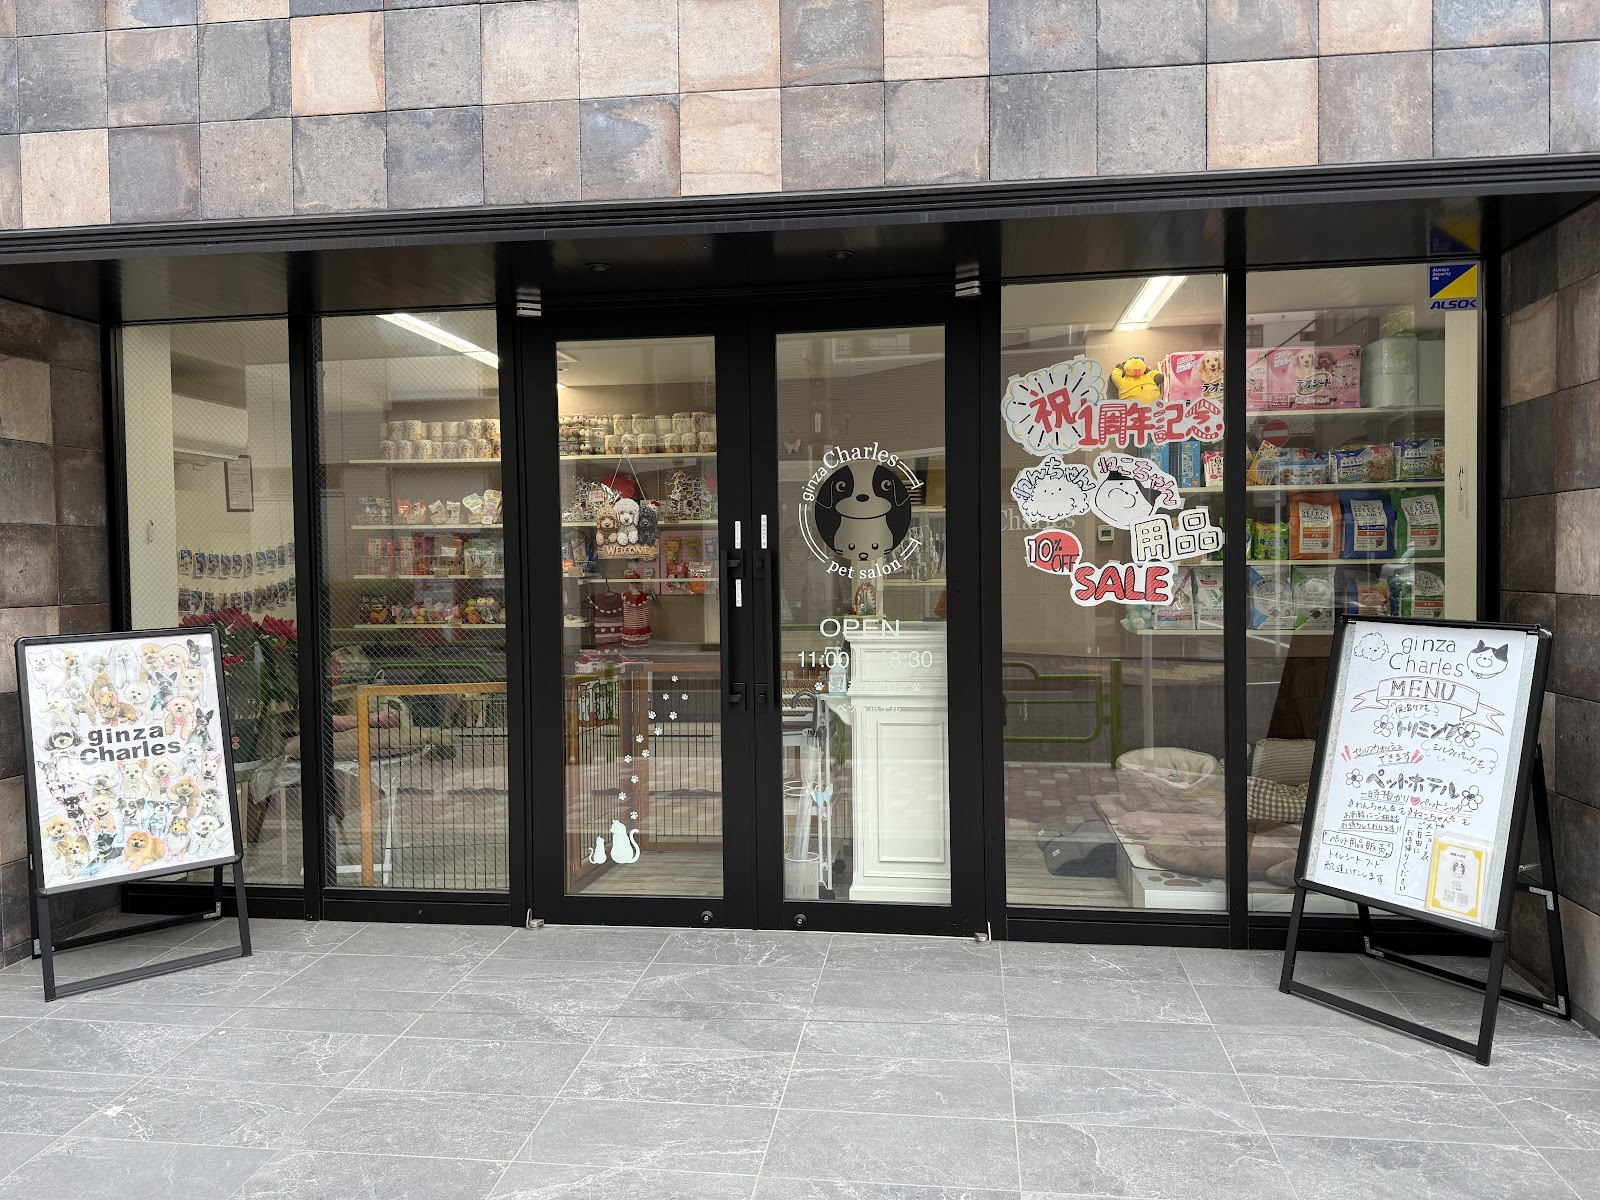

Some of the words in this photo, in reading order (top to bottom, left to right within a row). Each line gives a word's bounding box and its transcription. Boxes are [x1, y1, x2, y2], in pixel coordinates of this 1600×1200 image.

[1430, 299, 1477, 309] ALSOK
[1029, 387, 1086, 433] 祝
[1078, 398, 1223, 446] 1周年記念
[802, 466, 828, 502] ginza
[822, 442, 900, 469] Charles
[1013, 457, 1096, 500] わんちゃん
[1099, 456, 1178, 506] ねこちゃん
[1135, 512, 1220, 562] 用品
[605, 545, 650, 556] WELCOME
[1028, 538, 1063, 563] 10%
[825, 560, 855, 579] pet
[859, 558, 902, 579] salon
[1051, 553, 1080, 573] OFF
[1074, 566, 1170, 602] SALE
[819, 618, 900, 638] OPEN
[1401, 635, 1456, 654] ginza
[797, 650, 849, 669] 11:00
[1389, 652, 1465, 677] Charles
[1390, 679, 1456, 700] MENU
[87, 724, 164, 746] ginza
[1396, 719, 1467, 740] トリミング
[79, 739, 182, 765] Charles
[1378, 751, 1411, 765] できます
[1366, 769, 1460, 800] ペットホテル
[1356, 801, 1391, 813] わんちゃん
[1414, 809, 1451, 824] ねこちゃん
[1413, 821, 1427, 855] ご自由に
